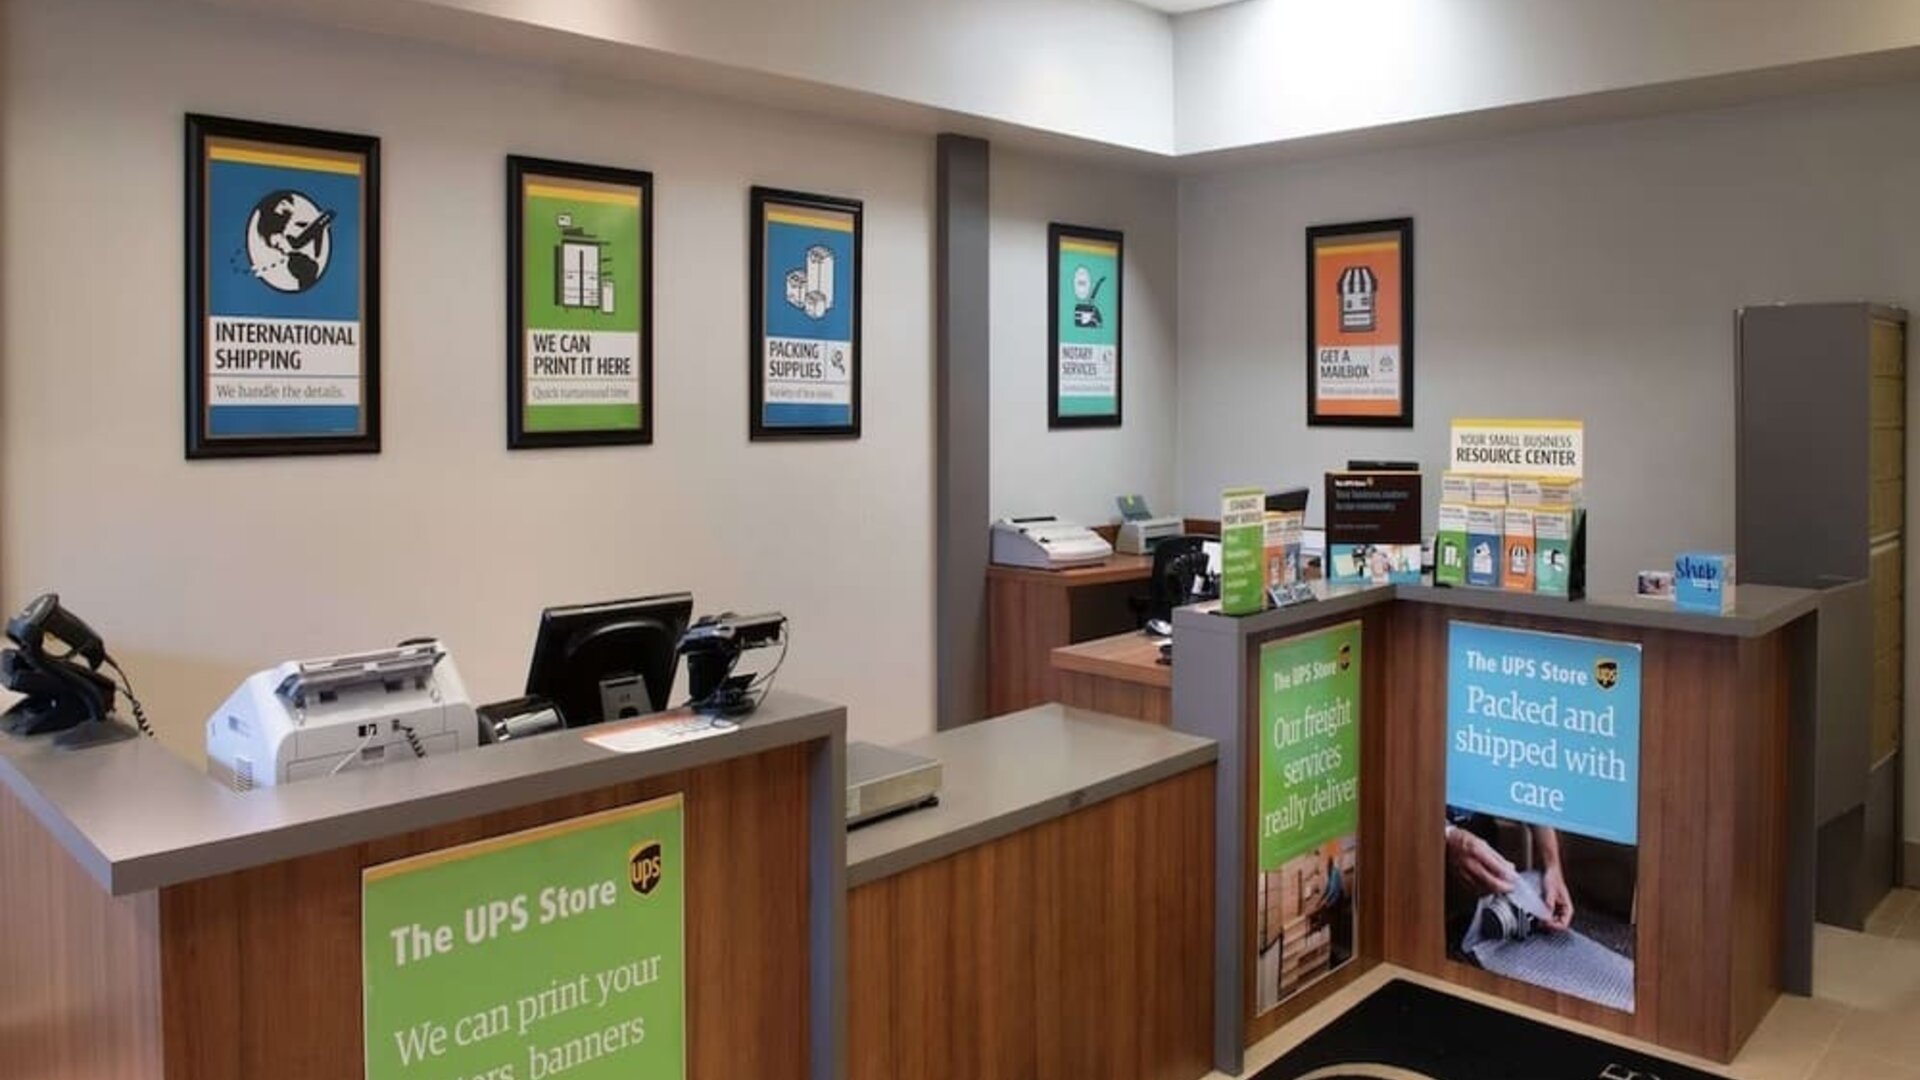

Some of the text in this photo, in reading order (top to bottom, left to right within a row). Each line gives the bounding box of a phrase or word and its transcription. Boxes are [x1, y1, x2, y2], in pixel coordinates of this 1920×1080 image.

[215, 322, 355, 346] INTERNATIONAL
[533, 334, 590, 353] WE CAN
[215, 348, 302, 370] SHIPPING
[769, 341, 819, 359] PACKING
[1320, 349, 1351, 363] GET A
[533, 356, 630, 375] PRINT IT HERE
[769, 360, 822, 378] SUPPLIES
[1062, 362, 1097, 375] SERVICES
[1320, 365, 1369, 379] MAILBOX
[216, 385, 236, 399] We
[238, 385, 279, 399] handle
[281, 385, 301, 399] the
[1460, 434, 1573, 448] YOUR SMALL BUSINESS
[1456, 448, 1577, 467] RESOURCE CENTER
[1274, 661, 1337, 693] The UPS Store
[1466, 650, 1588, 686] The UPS Store
[1274, 697, 1351, 750] Our freight
[1466, 685, 1615, 738] Packed and
[1284, 743, 1342, 788] services
[1456, 724, 1627, 782] shipped with
[1264, 777, 1357, 837] really deliver
[1510, 780, 1565, 812] care
[633, 855, 660, 889] ups
[390, 880, 617, 966] The UPS Store
[394, 955, 661, 1067] We can print your
[529, 1016, 646, 1080] banners
